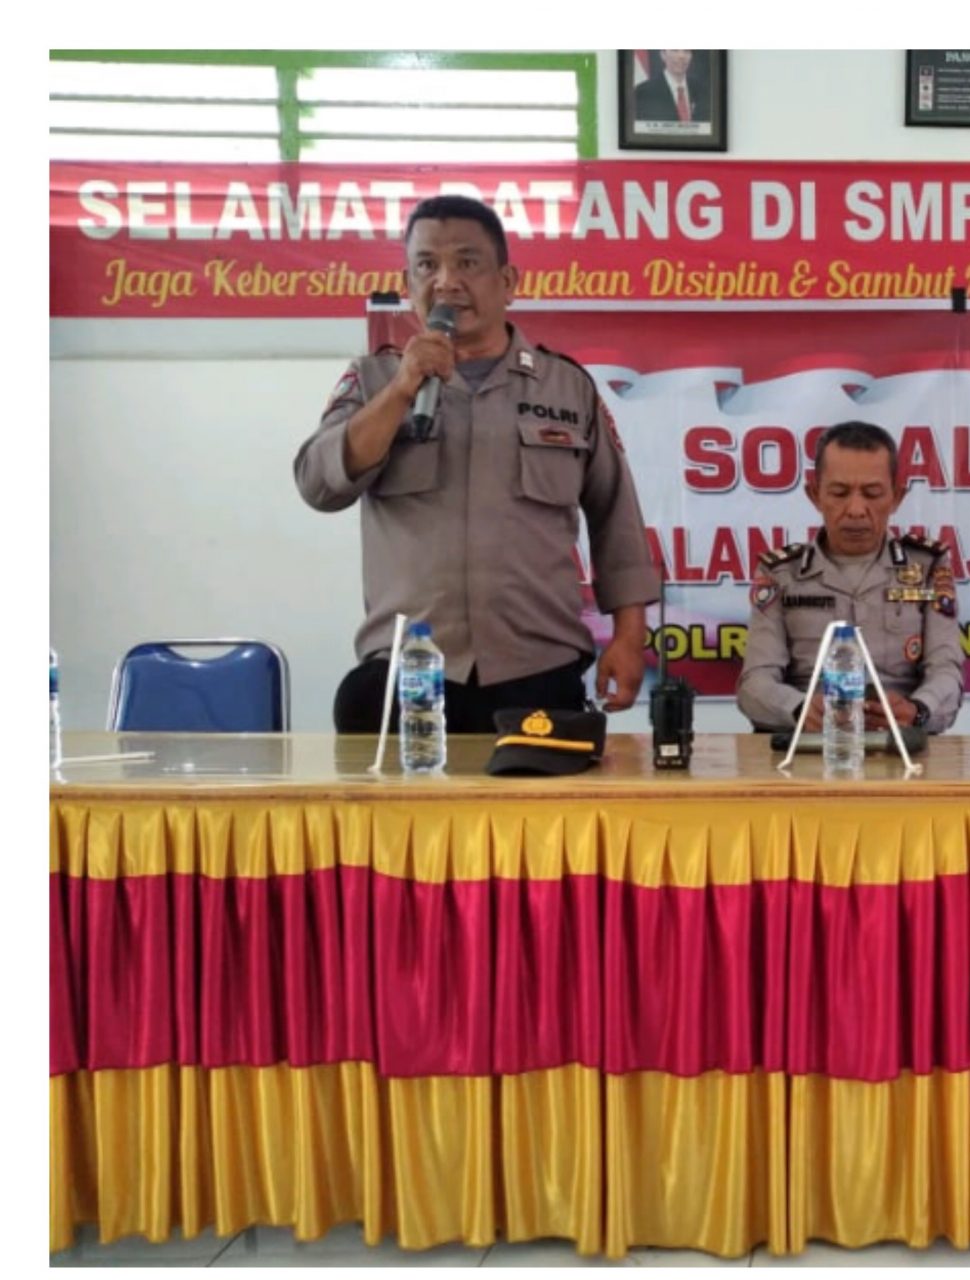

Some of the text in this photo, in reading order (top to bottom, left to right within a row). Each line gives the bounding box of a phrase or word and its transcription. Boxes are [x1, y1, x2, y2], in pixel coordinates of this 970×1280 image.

[77, 180, 413, 241] SELAMAT
[750, 181, 816, 241] DI
[102, 259, 197, 308] Jaga
[643, 259, 781, 301] Disiplin
[789, 261, 818, 298] &
[826, 260, 956, 299] Sambut
[517, 402, 579, 426] POLRI
